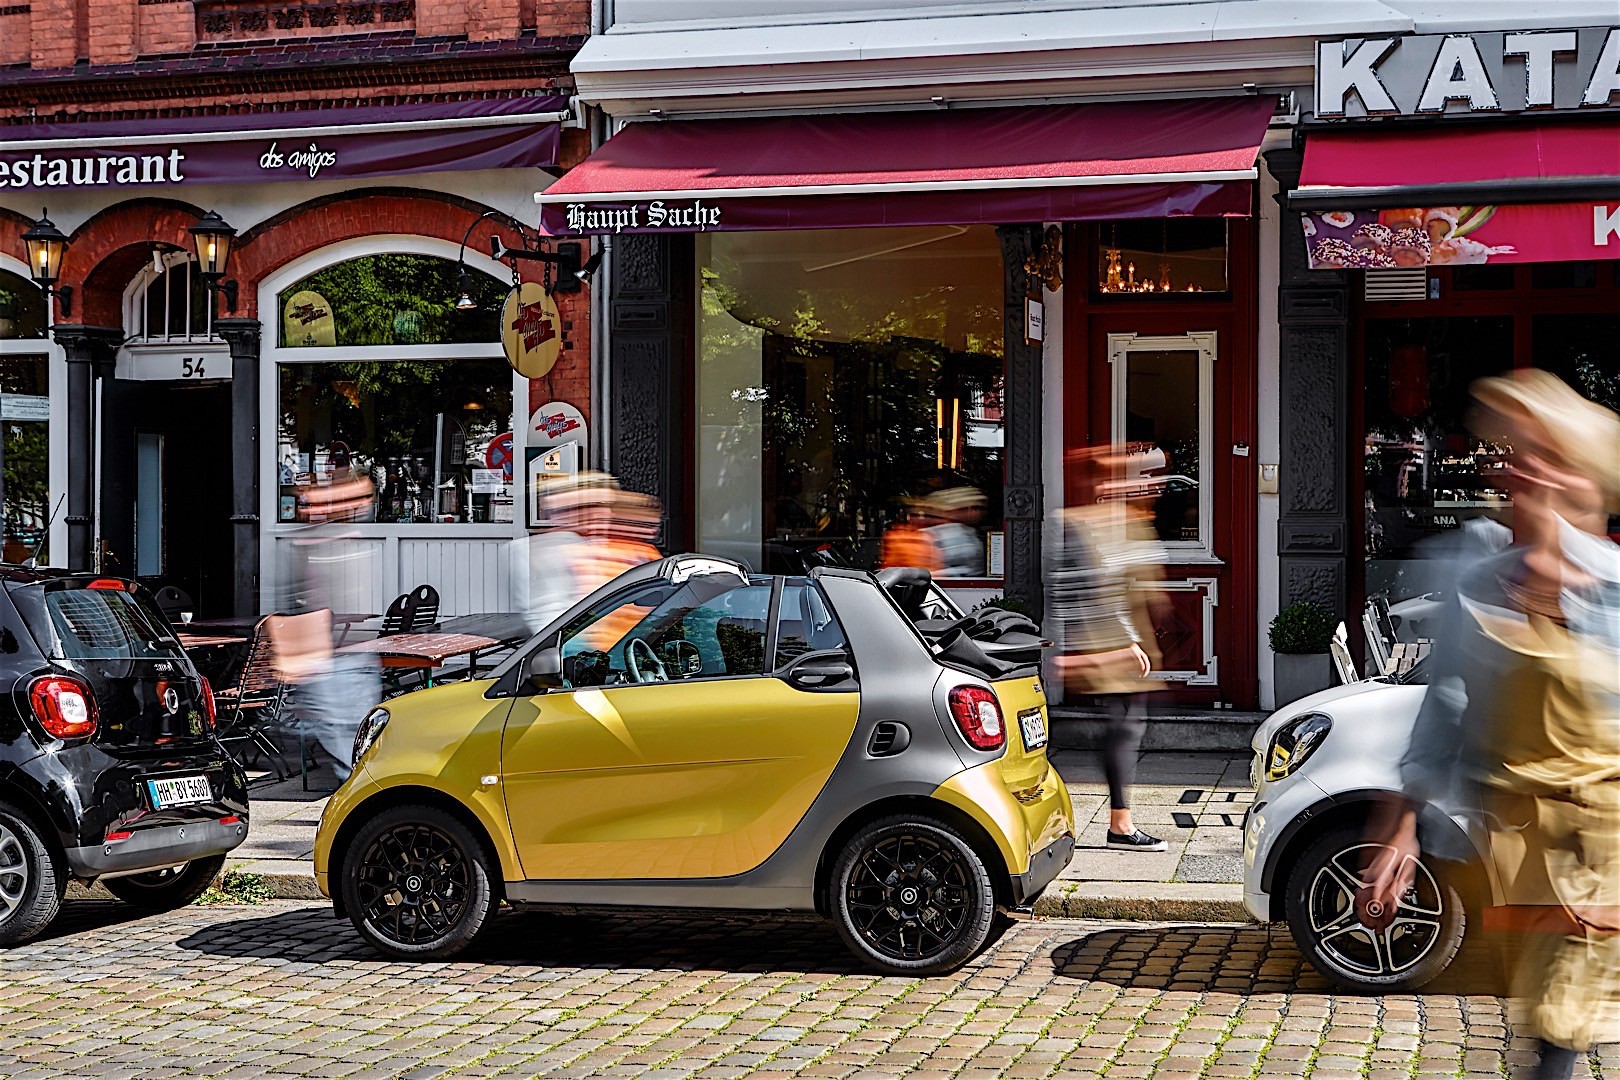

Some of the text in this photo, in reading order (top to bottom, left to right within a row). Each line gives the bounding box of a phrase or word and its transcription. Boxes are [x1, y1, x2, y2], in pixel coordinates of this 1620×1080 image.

[0, 148, 185, 188] estaurant
[259, 142, 337, 178] dos amigos
[566, 200, 722, 235] Haupt Sache
[181, 357, 205, 378] 54
[156, 782, 173, 803] HH
